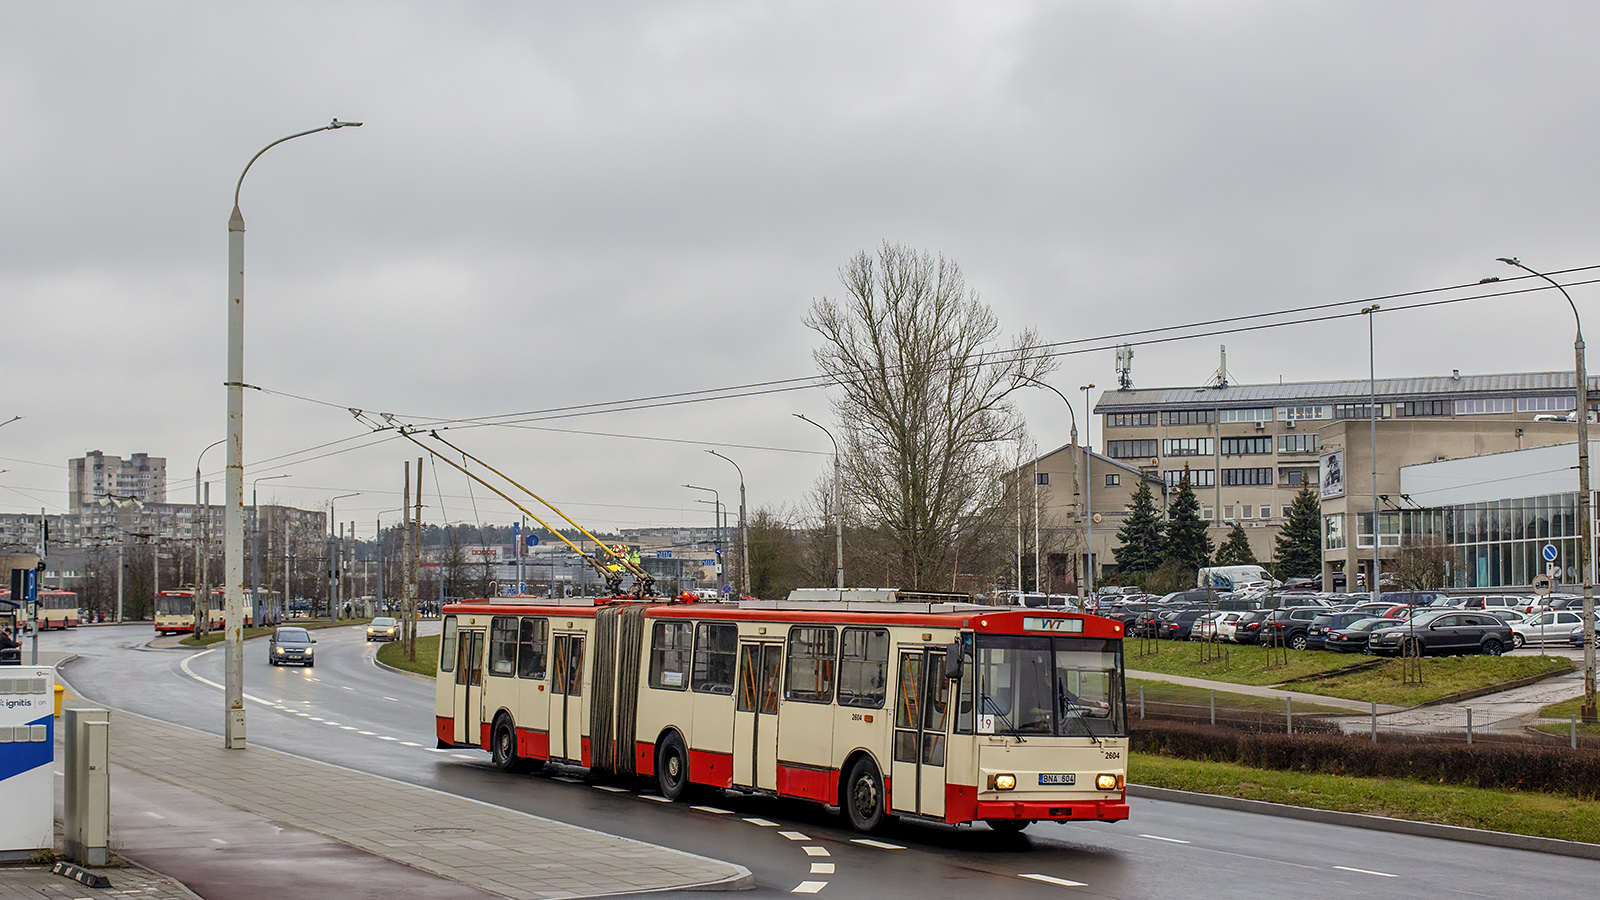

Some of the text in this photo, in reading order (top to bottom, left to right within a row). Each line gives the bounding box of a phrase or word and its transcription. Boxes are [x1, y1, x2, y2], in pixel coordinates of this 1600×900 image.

[1042, 620, 1064, 629] VVT
[6, 699, 31, 709] ignitis
[981, 719, 991, 728] 19
